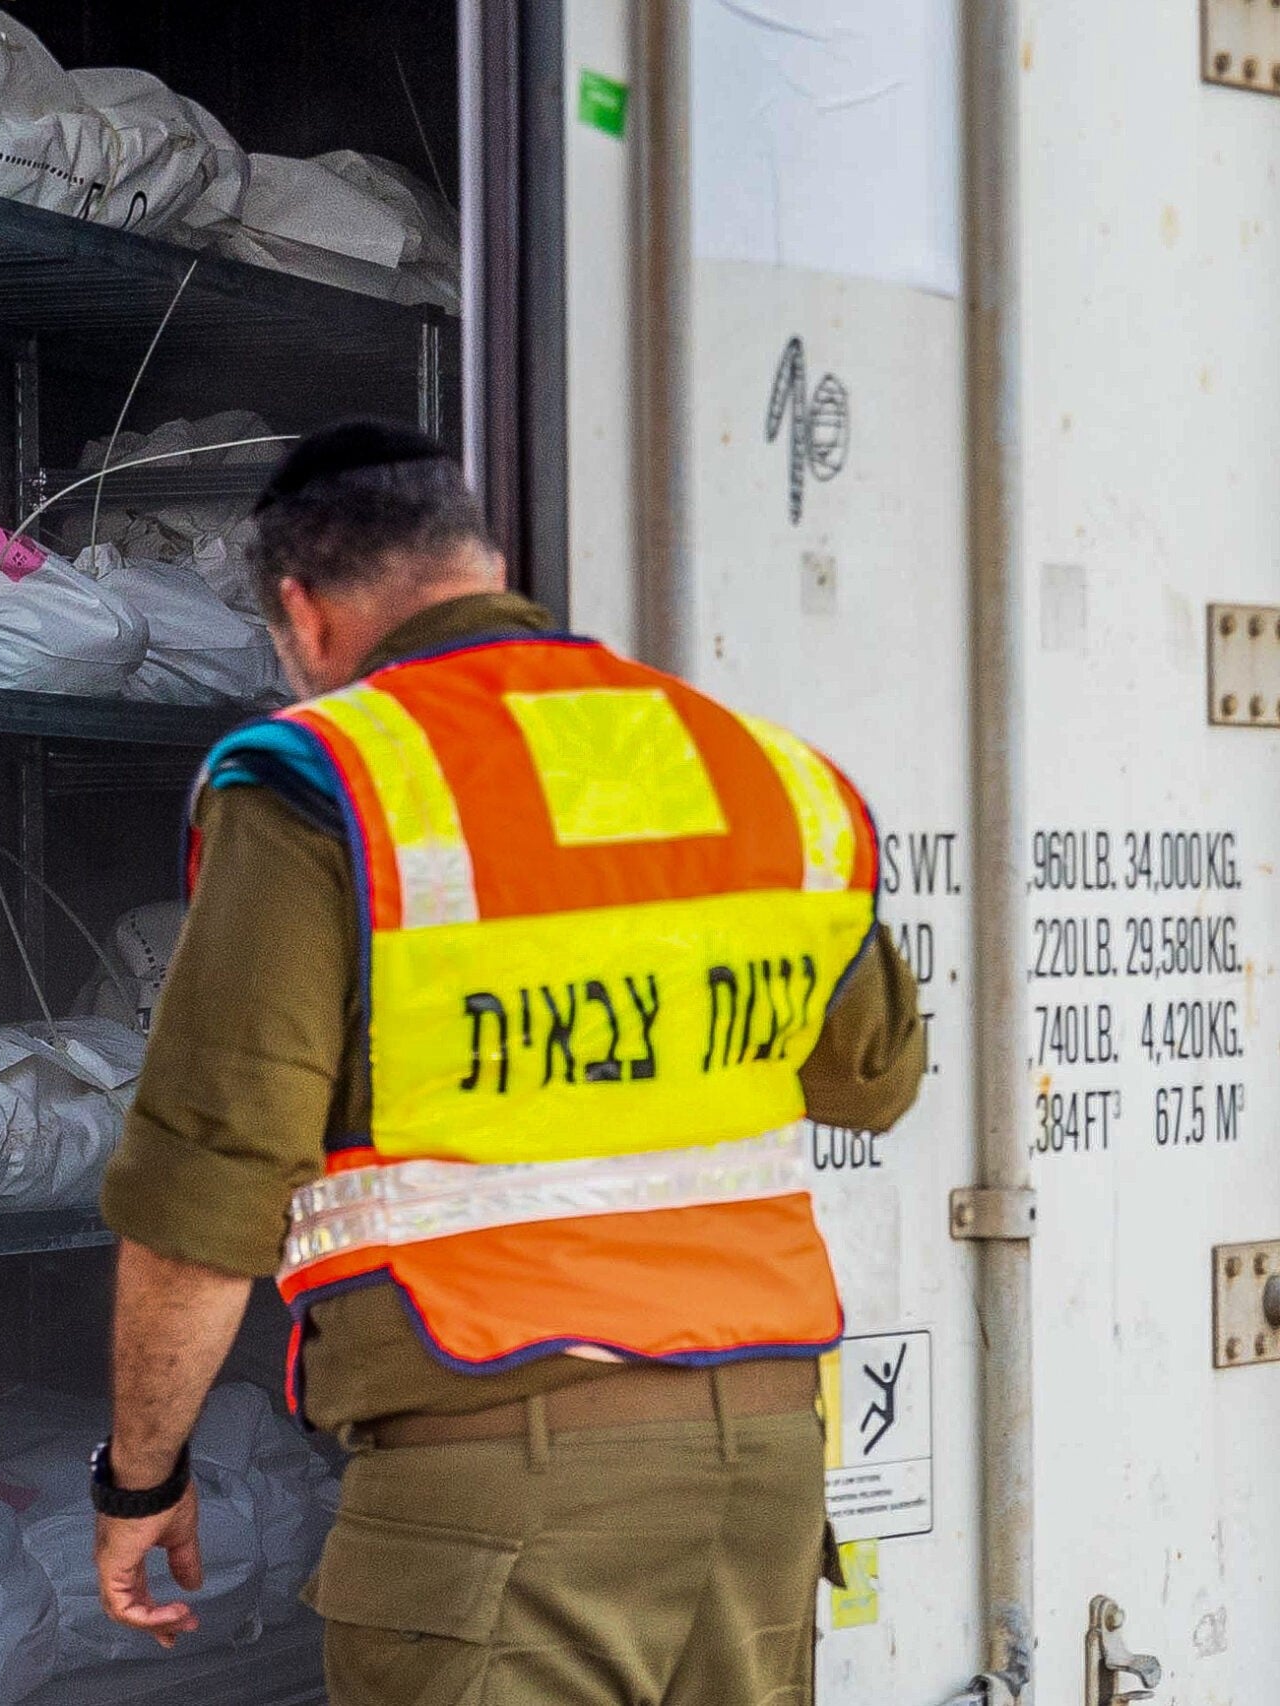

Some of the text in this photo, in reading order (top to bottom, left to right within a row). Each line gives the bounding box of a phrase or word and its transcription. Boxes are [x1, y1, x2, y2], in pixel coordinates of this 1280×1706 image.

[908, 832, 960, 895] WT.
[460, 973, 658, 1094] צבאית
[1155, 1084, 1205, 1146] 67.5
